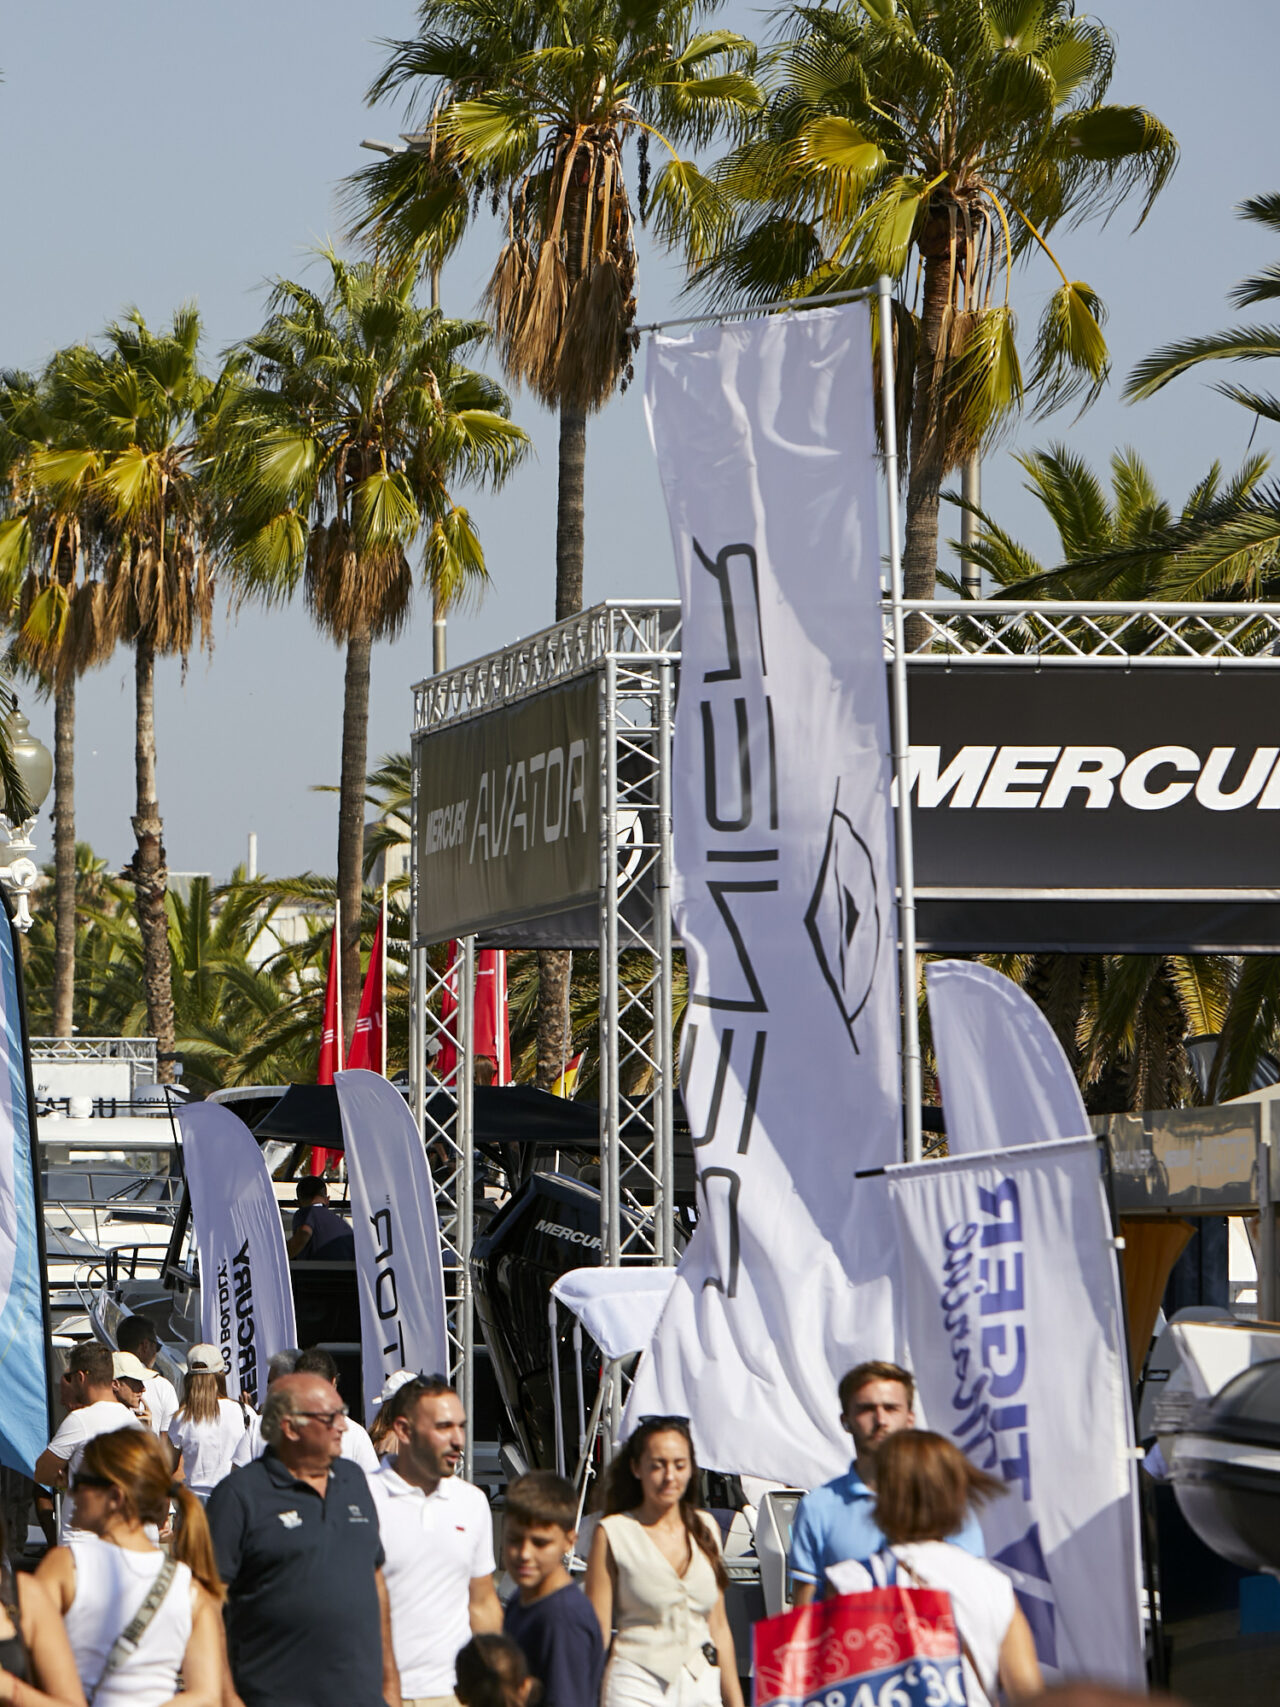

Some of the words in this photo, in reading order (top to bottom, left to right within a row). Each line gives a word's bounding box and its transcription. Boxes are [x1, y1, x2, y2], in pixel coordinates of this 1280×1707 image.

[425, 799, 469, 856] MERCURY
[470, 739, 587, 864] AVATOR
[892, 744, 1280, 811] MERCU
[38, 1083, 48, 1091] by
[534, 1219, 602, 1251] MERCUR
